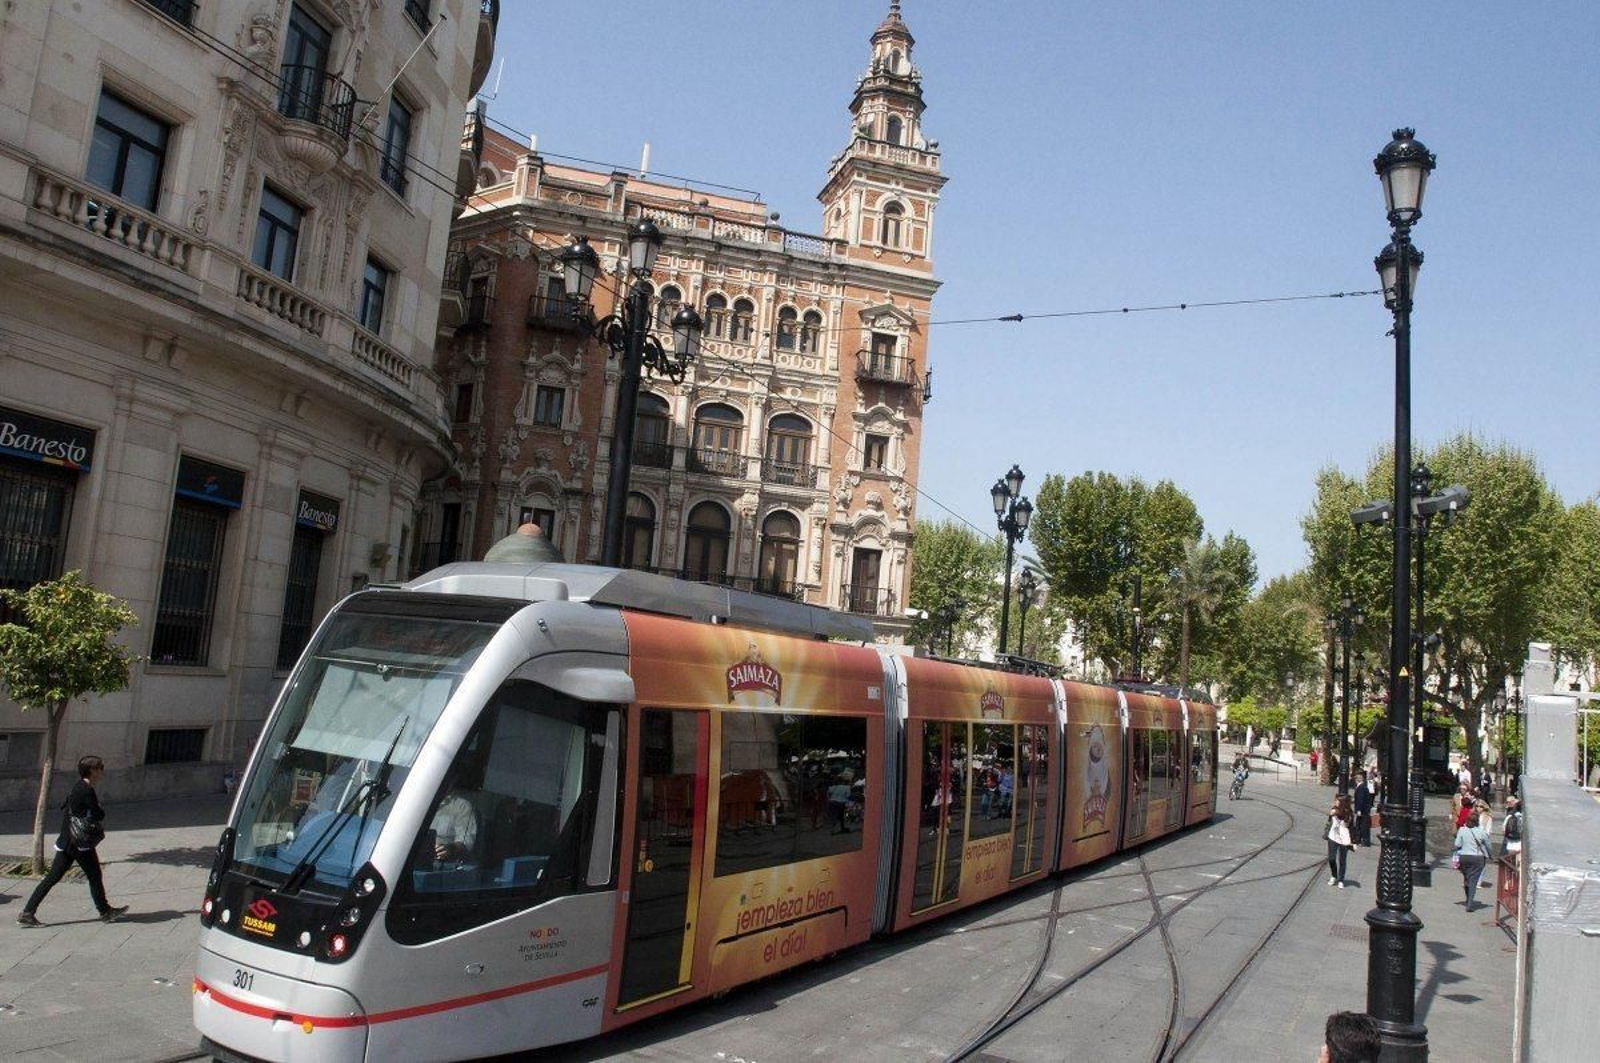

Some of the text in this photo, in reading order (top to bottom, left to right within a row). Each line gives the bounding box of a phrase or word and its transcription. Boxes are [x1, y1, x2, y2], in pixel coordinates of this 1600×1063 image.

[0, 422, 87, 466] Banesto
[299, 501, 336, 528] Banesto
[729, 665, 778, 690] SAIMAZA
[806, 887, 834, 913] bien
[244, 915, 276, 932] TUSSAM
[763, 937, 779, 962] el
[233, 968, 255, 991] 301
